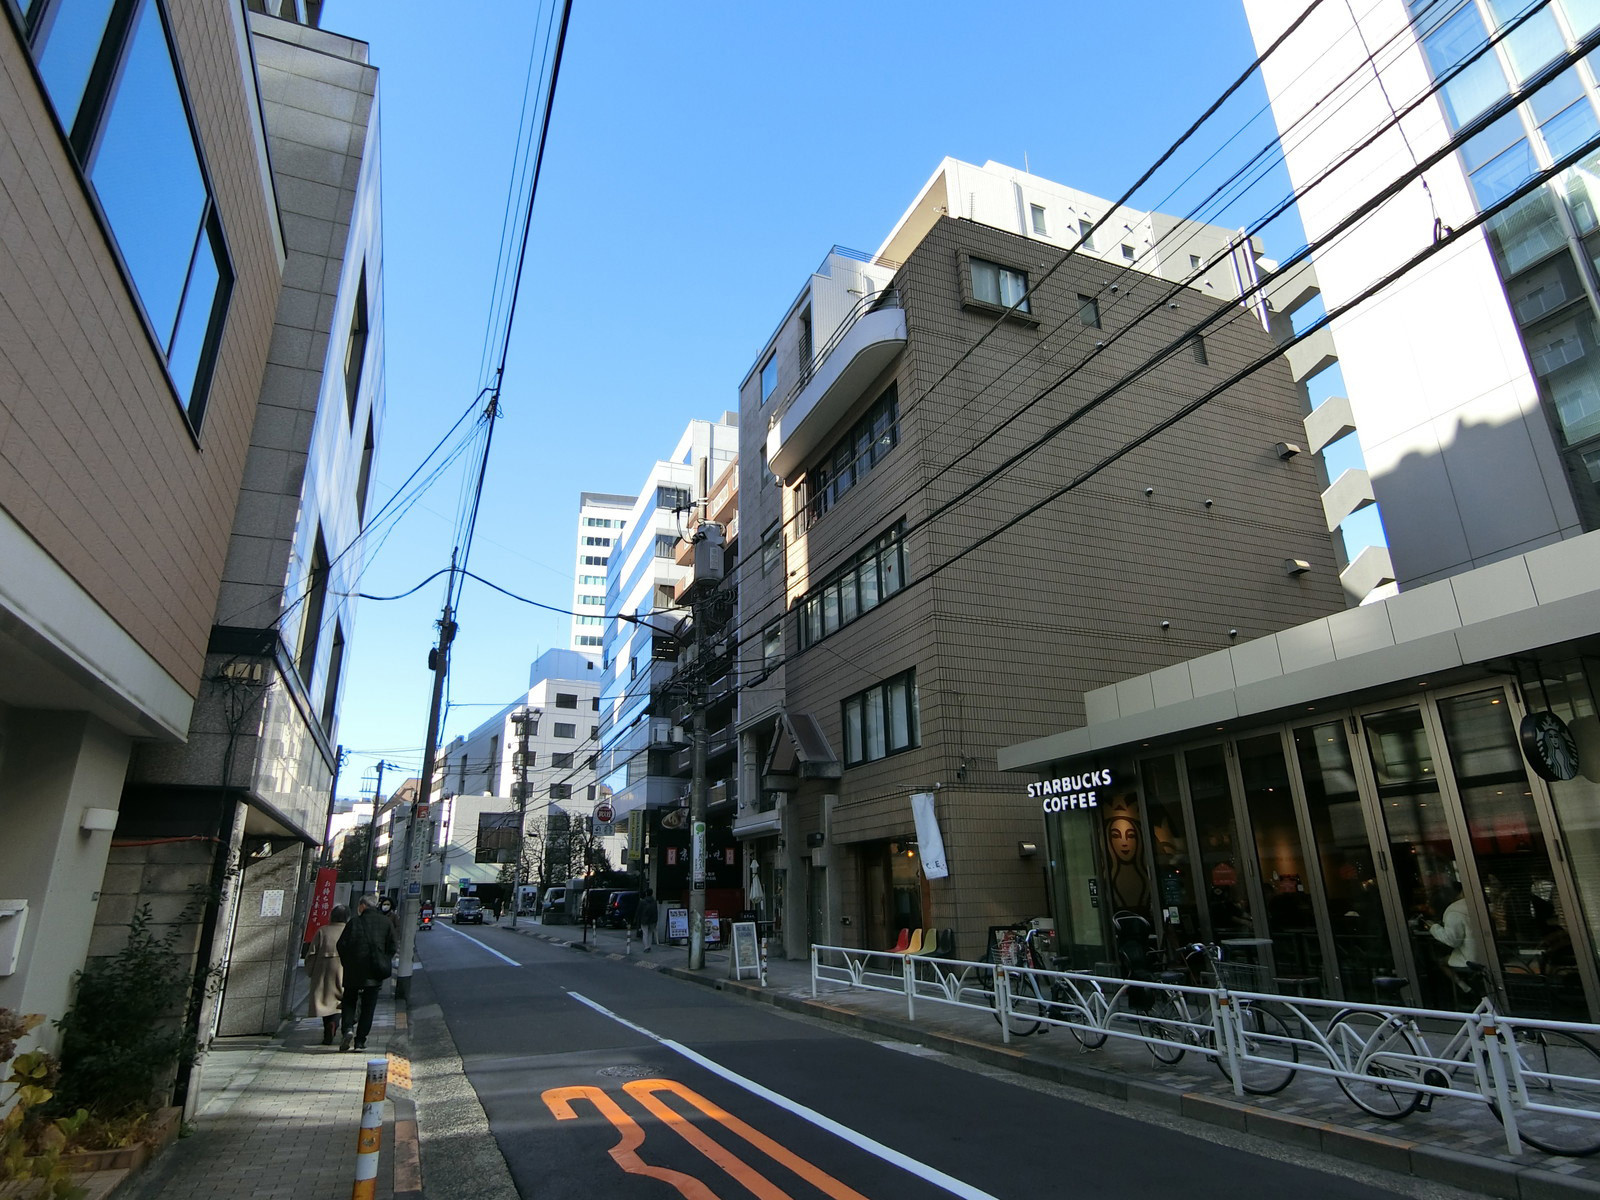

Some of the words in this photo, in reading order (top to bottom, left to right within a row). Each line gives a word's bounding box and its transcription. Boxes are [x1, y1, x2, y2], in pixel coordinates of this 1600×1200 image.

[1027, 768, 1112, 798] STARBUCKS
[1042, 791, 1098, 813] COFFEE
[321, 880, 331, 917] お持ち帰り
